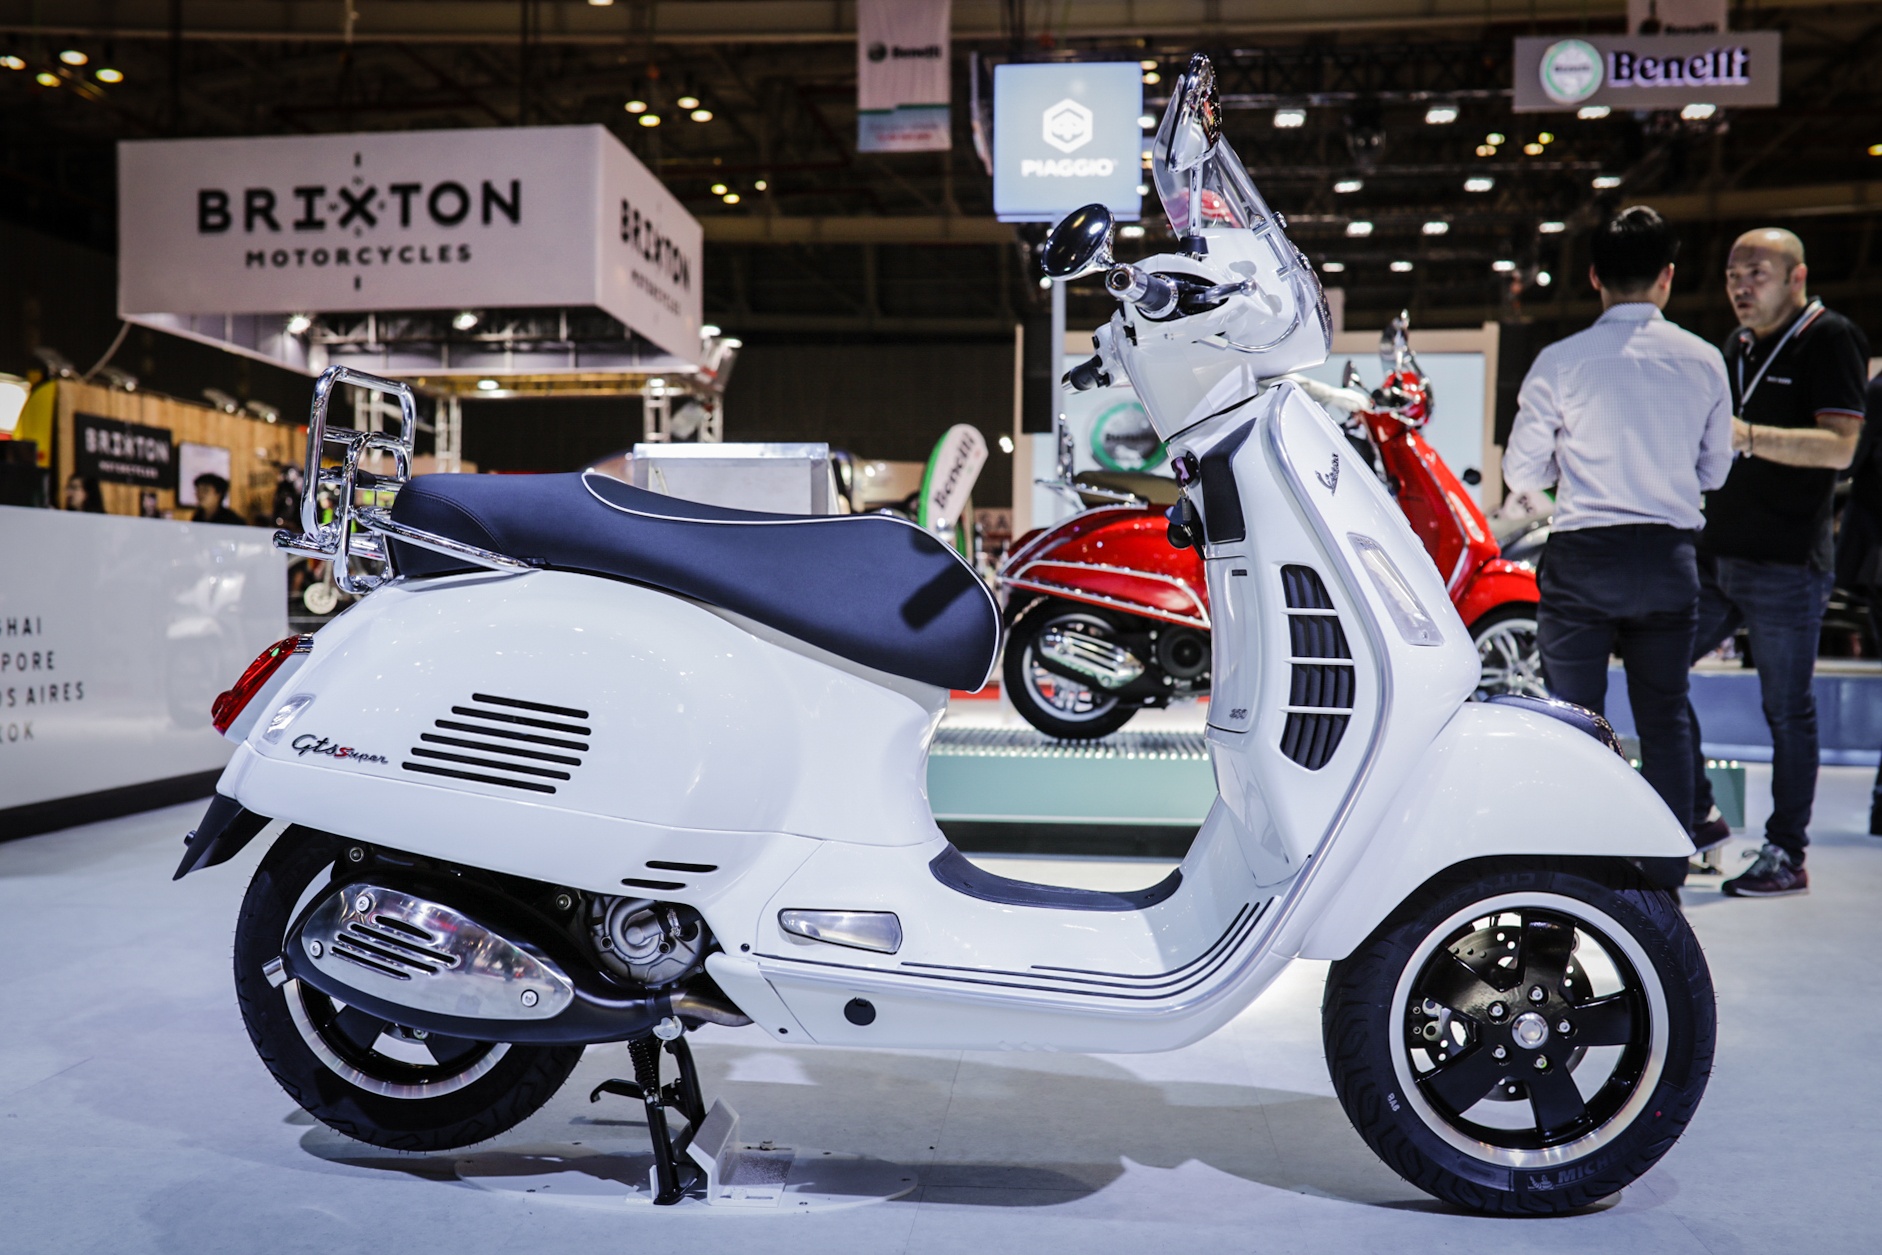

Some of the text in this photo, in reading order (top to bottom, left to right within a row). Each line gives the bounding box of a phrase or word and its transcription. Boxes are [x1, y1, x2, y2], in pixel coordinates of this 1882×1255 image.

[1608, 46, 1749, 87] Benelli
[1021, 159, 1114, 178] PIAGGIO
[197, 179, 522, 234] BRIXTON
[245, 244, 472, 268] MOTORCYCLES
[85, 426, 170, 464] BRIXTON
[0, 616, 42, 636] HAI
[26, 681, 84, 705] AIRES
[0, 721, 34, 743] OK
